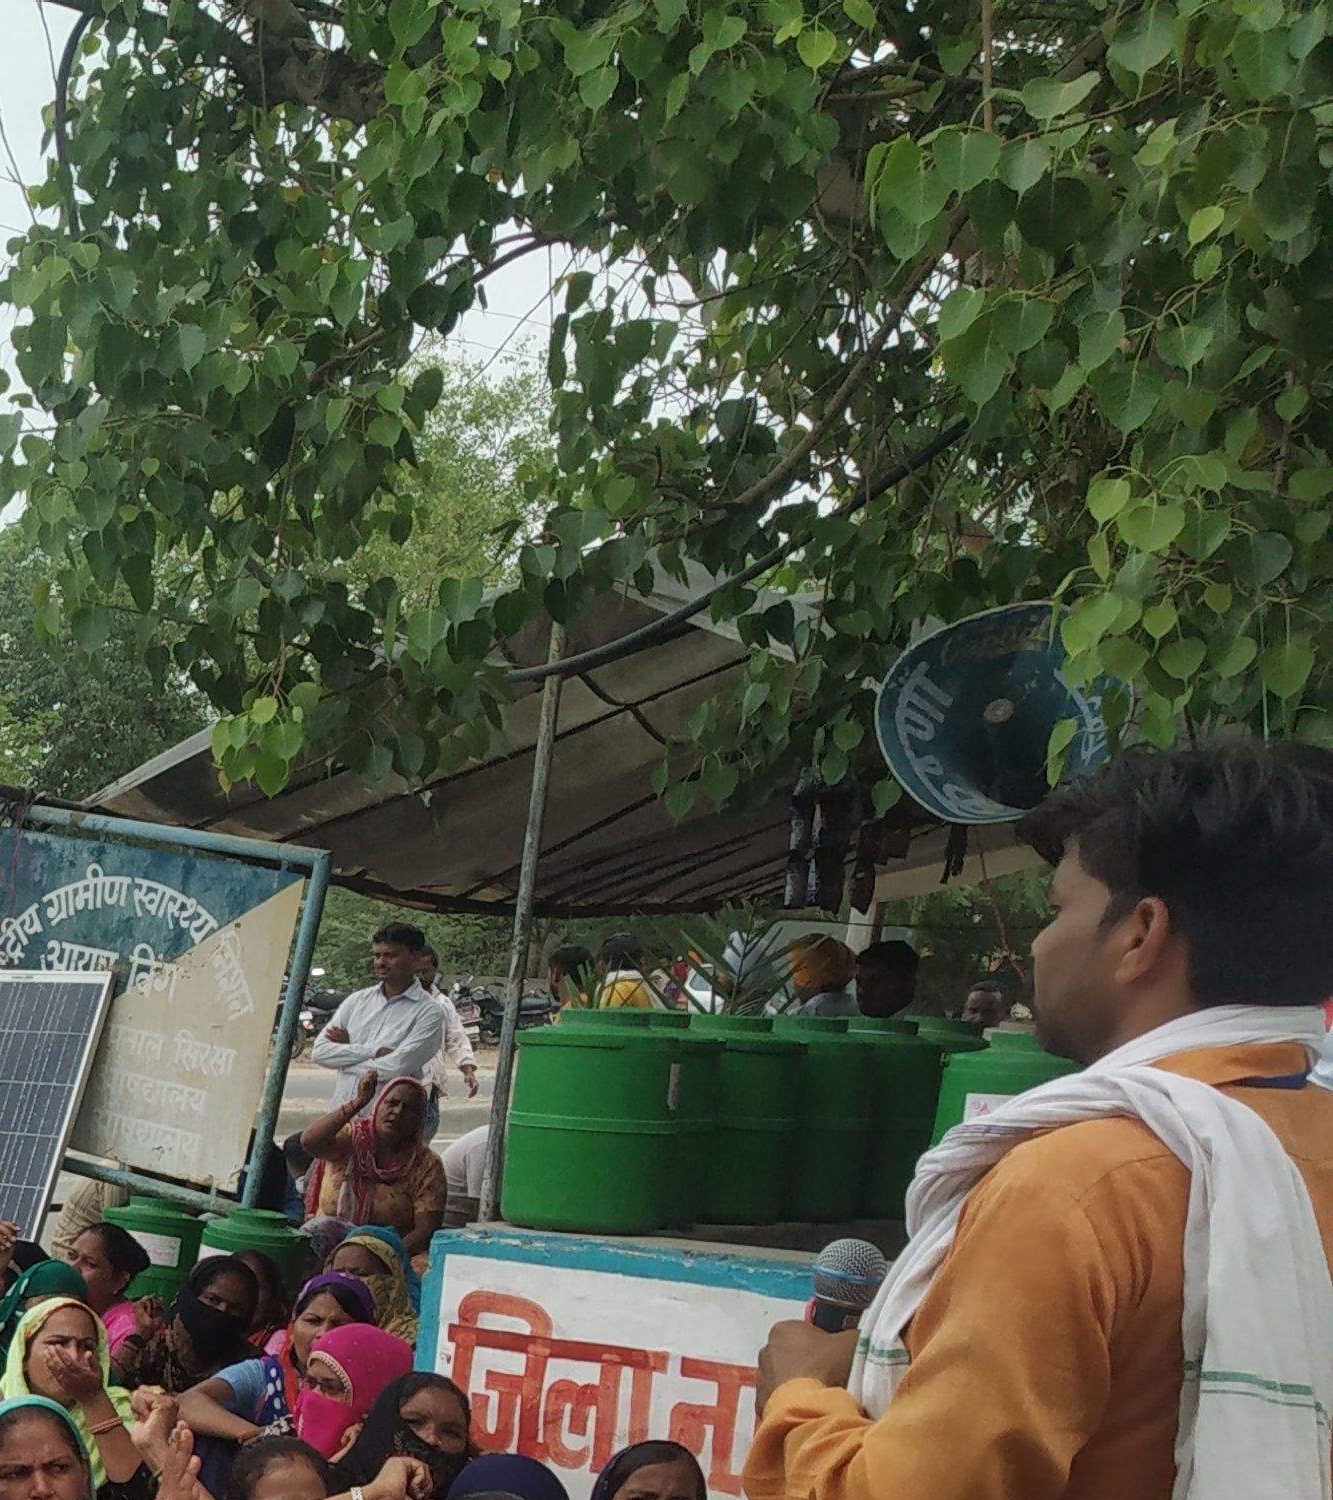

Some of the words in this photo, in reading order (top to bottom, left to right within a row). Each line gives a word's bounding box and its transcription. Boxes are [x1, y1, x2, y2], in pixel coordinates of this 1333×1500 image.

[42, 863, 132, 927] ग्रामीण
[133, 877, 219, 944] स्वास्थ्य
[175, 1029, 238, 1077] सिरसा
[448, 1289, 670, 1474] जिला
